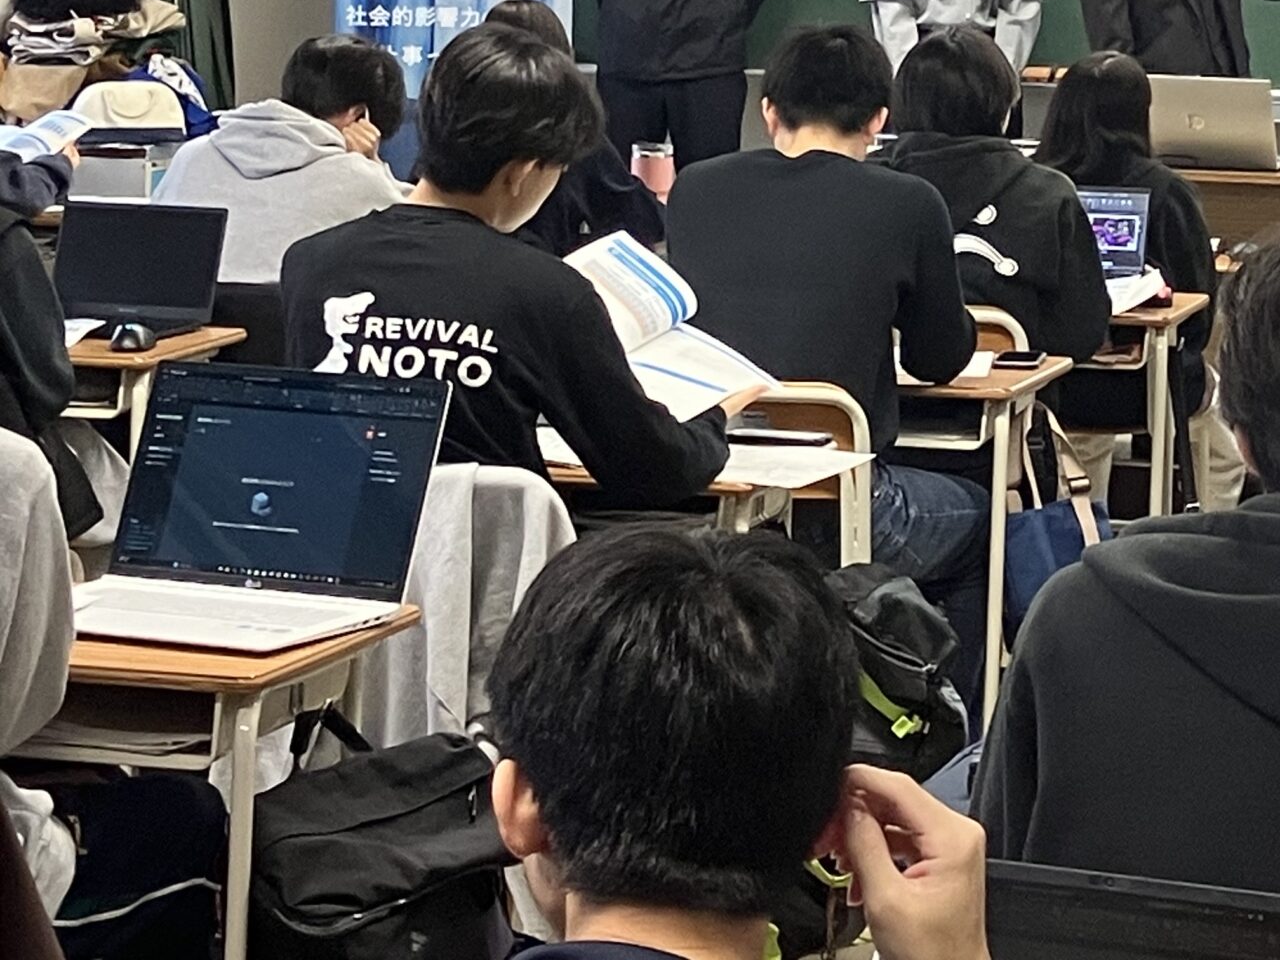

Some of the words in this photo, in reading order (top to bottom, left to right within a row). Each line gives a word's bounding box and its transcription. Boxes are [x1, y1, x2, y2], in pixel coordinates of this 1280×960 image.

[345, 4, 488, 28] 社会的影響力
[364, 316, 498, 353] REVIVAL
[358, 344, 492, 387] NOTO
